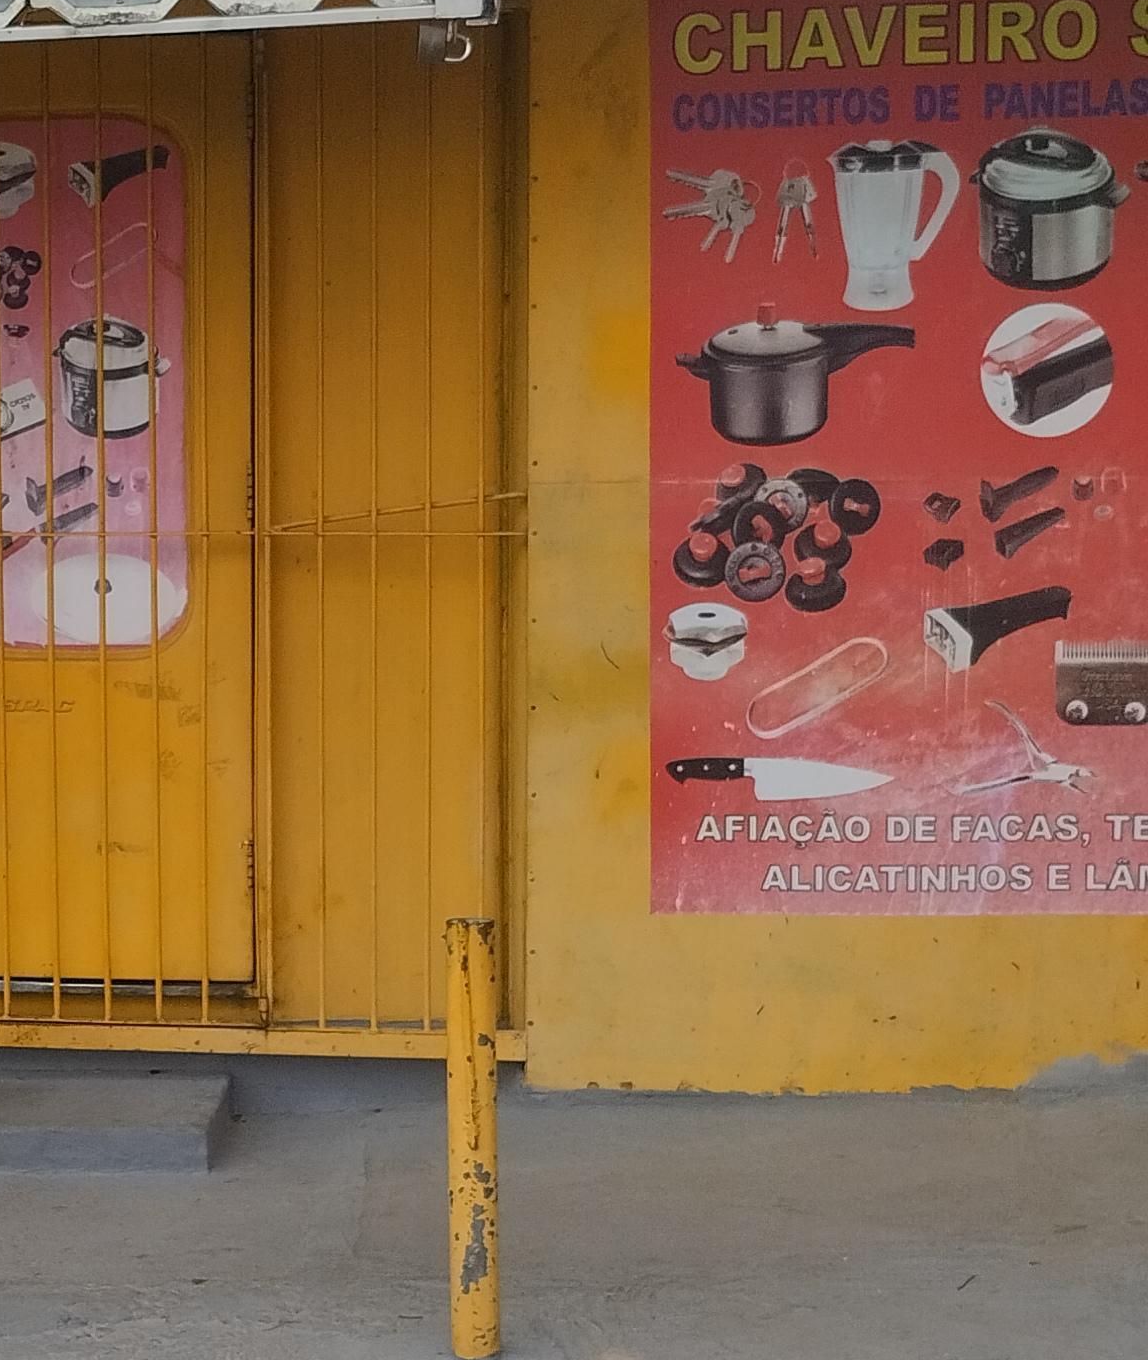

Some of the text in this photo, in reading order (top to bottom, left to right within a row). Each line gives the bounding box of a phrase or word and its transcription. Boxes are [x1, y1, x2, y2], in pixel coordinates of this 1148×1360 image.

[672, 77, 1148, 132] CONSERTOS DE PANELAS
[695, 807, 871, 847] AFIAÇÃO
[885, 814, 936, 842] DE
[952, 814, 1091, 848] FACAS,
[761, 864, 1033, 892] ALICATINHOS
[1047, 863, 1072, 891] E
